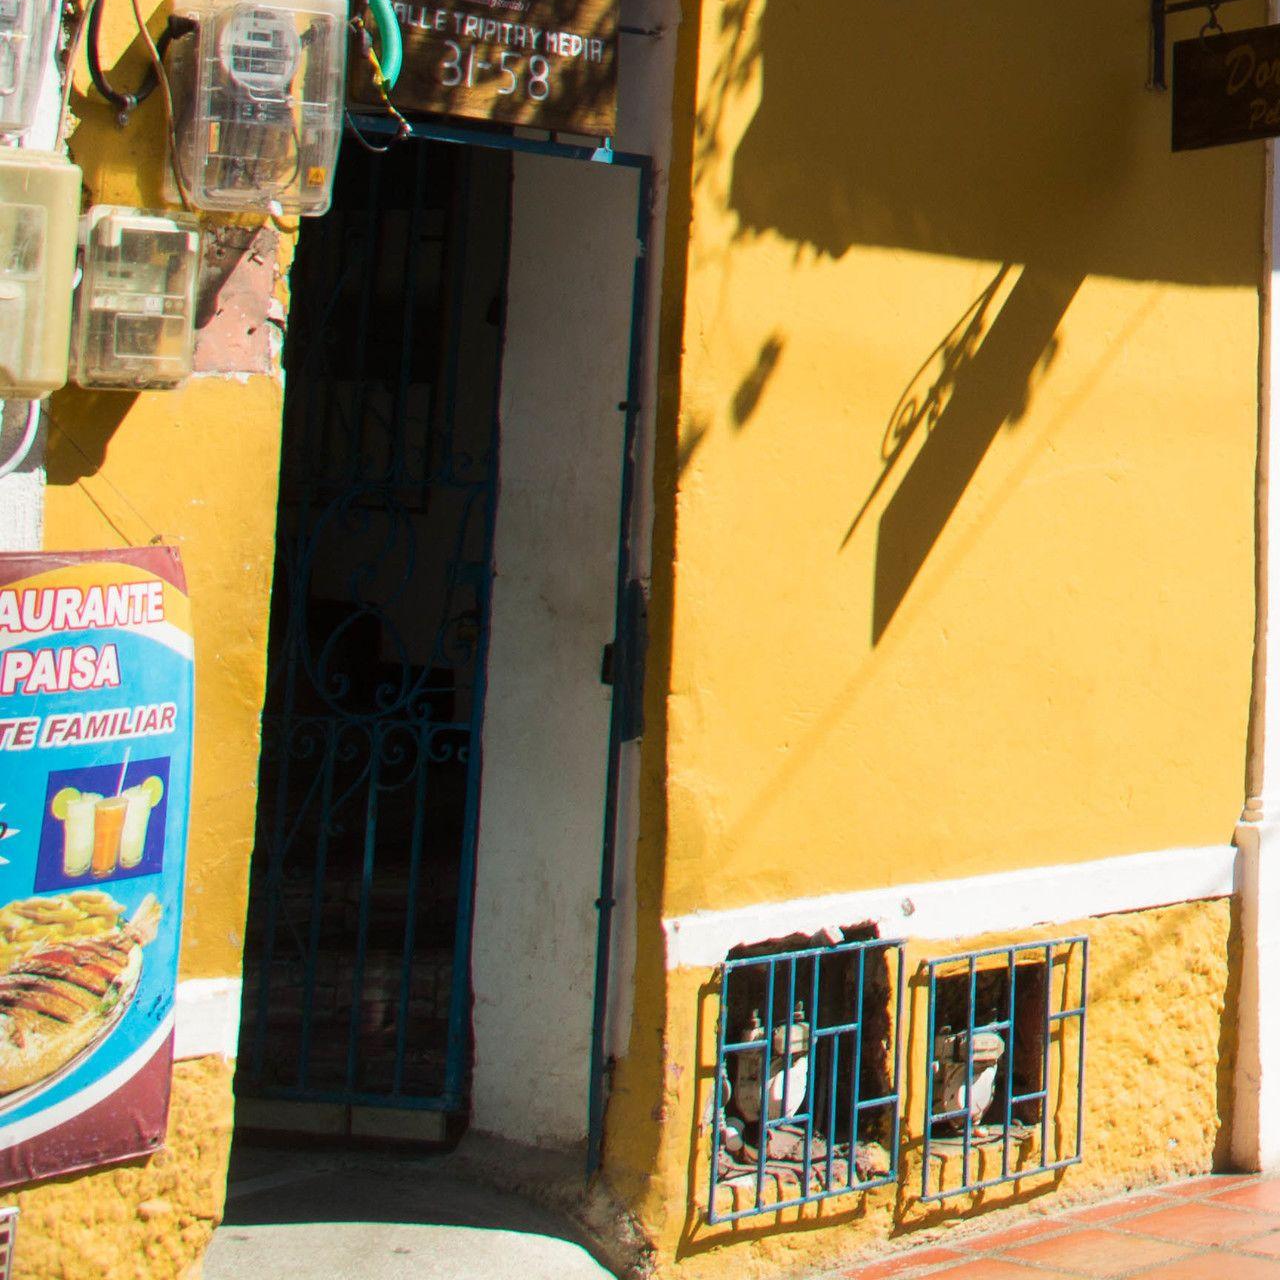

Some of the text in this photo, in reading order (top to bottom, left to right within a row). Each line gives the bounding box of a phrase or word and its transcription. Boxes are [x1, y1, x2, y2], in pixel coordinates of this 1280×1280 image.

[393, 2, 447, 31] ALLE
[546, 31, 604, 63] MEDIA
[442, 40, 549, 101] 31-58
[2, 645, 120, 694] PAISA
[43, 705, 177, 745] FAMILIAR
